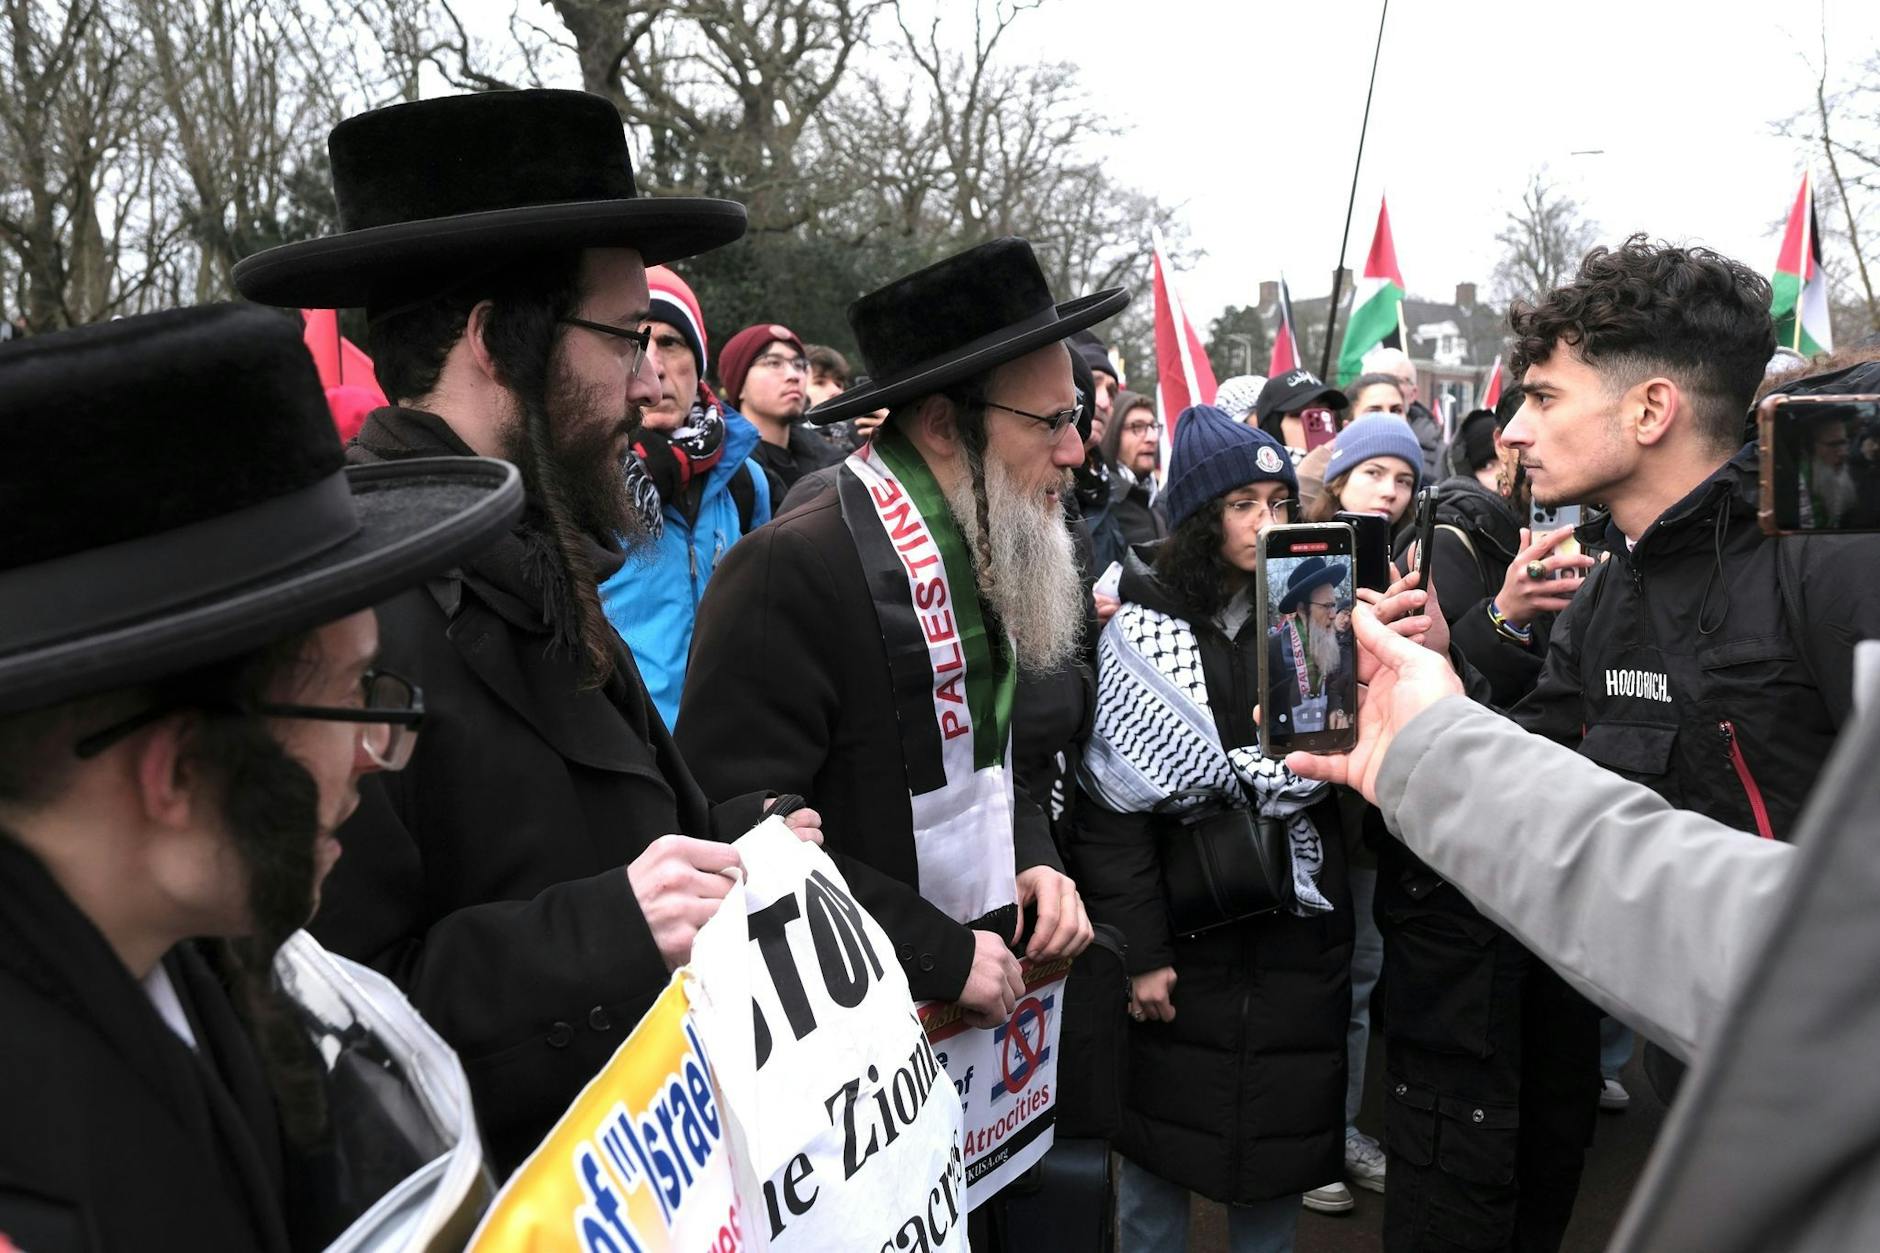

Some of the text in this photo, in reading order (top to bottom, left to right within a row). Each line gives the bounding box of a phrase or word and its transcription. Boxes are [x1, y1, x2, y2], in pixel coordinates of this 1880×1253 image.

[871, 478, 969, 741] PALESTINE
[824, 1012, 940, 1181] Zioni
[963, 1084, 1051, 1160] Atrocities
